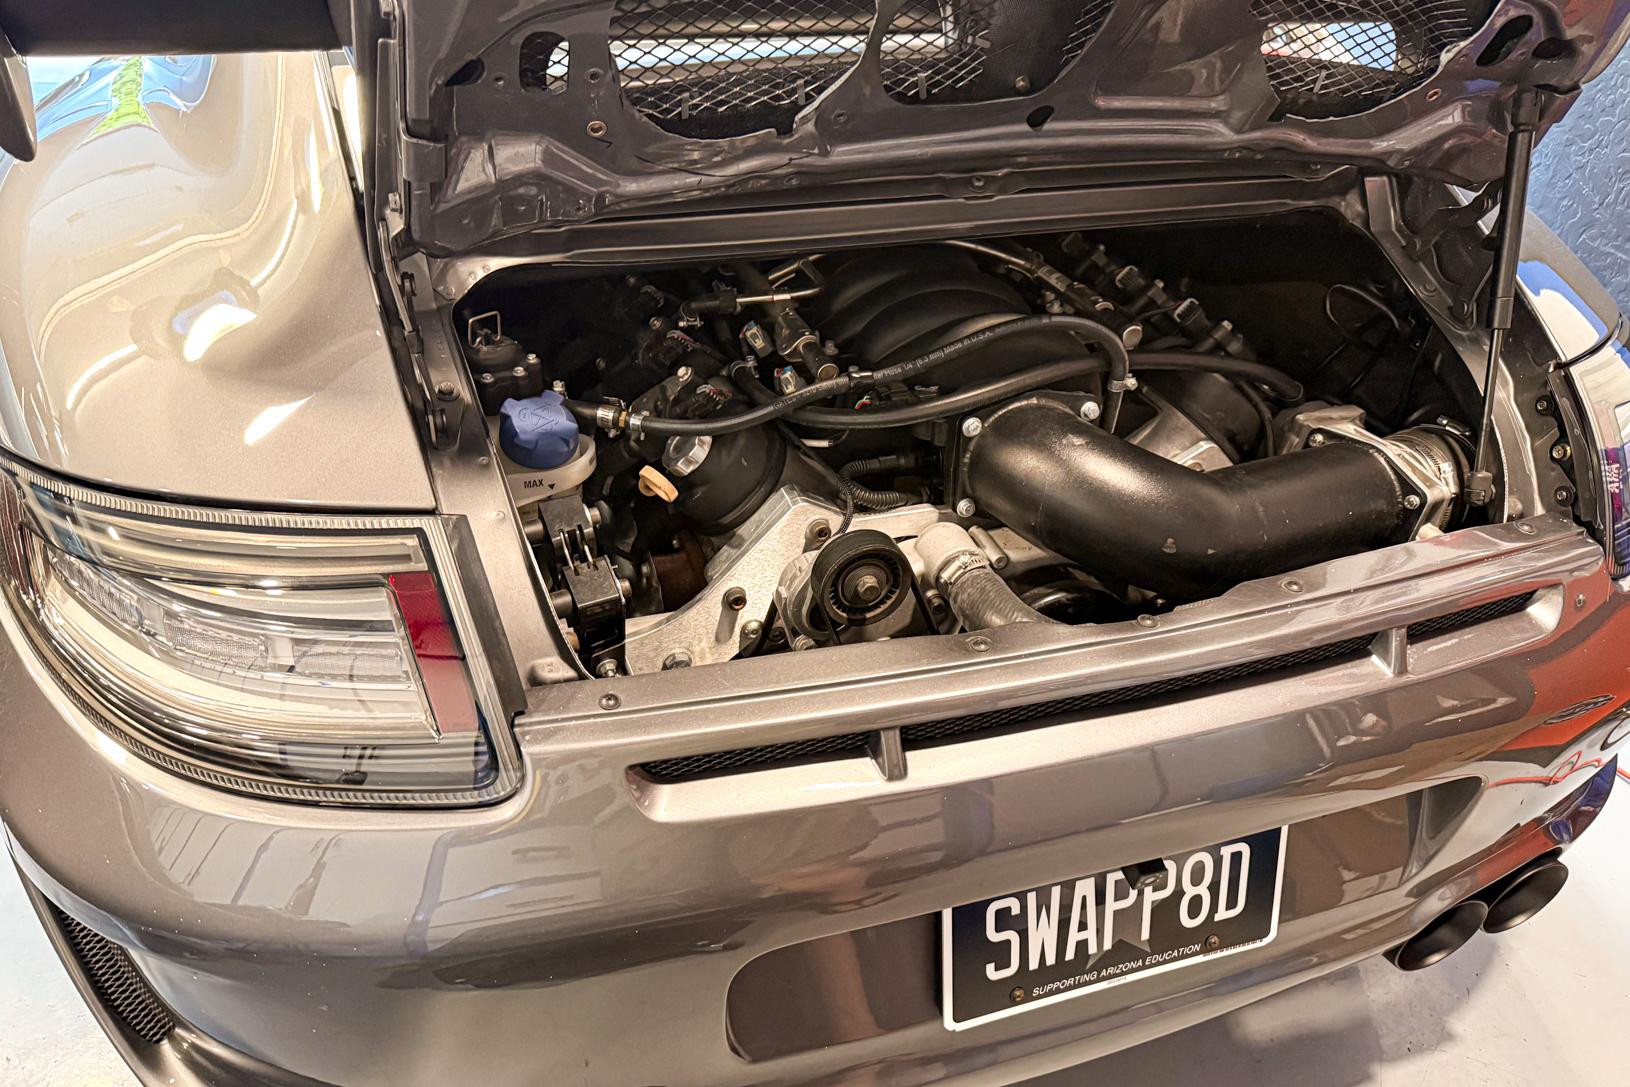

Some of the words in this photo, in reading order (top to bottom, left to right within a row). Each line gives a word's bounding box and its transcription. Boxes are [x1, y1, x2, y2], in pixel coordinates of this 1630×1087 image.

[944, 342, 962, 354] Made
[524, 479, 544, 489] MAX
[985, 841, 1250, 981] SWAPP8D
[1032, 971, 1098, 997] SUPPORTING
[1100, 958, 1143, 978] ARIZONA
[1145, 943, 1201, 966] EDUCATION
